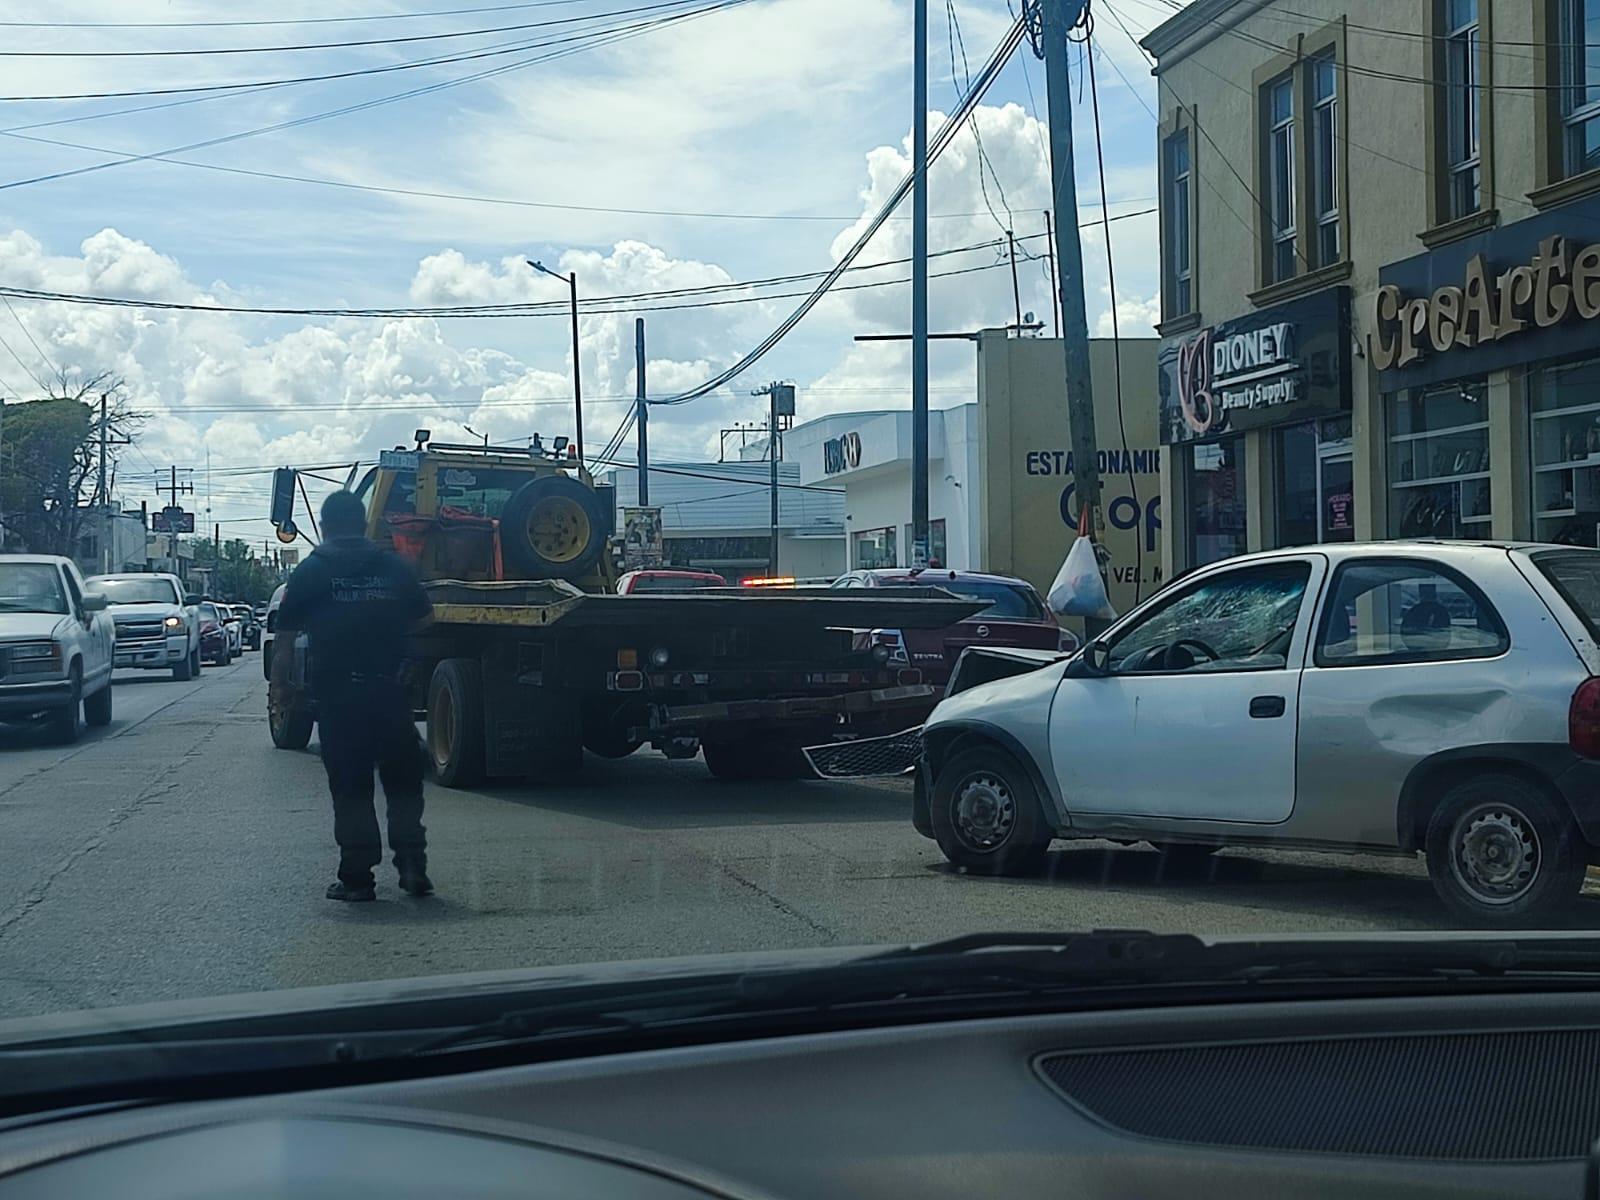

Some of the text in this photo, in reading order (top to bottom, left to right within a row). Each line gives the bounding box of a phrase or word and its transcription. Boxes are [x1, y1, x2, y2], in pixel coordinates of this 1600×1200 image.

[1367, 234, 1600, 370] CreArte
[1214, 323, 1288, 375] DIONEY
[1222, 377, 1293, 409] Beauty Supply
[1113, 567, 1147, 583] VEL.
